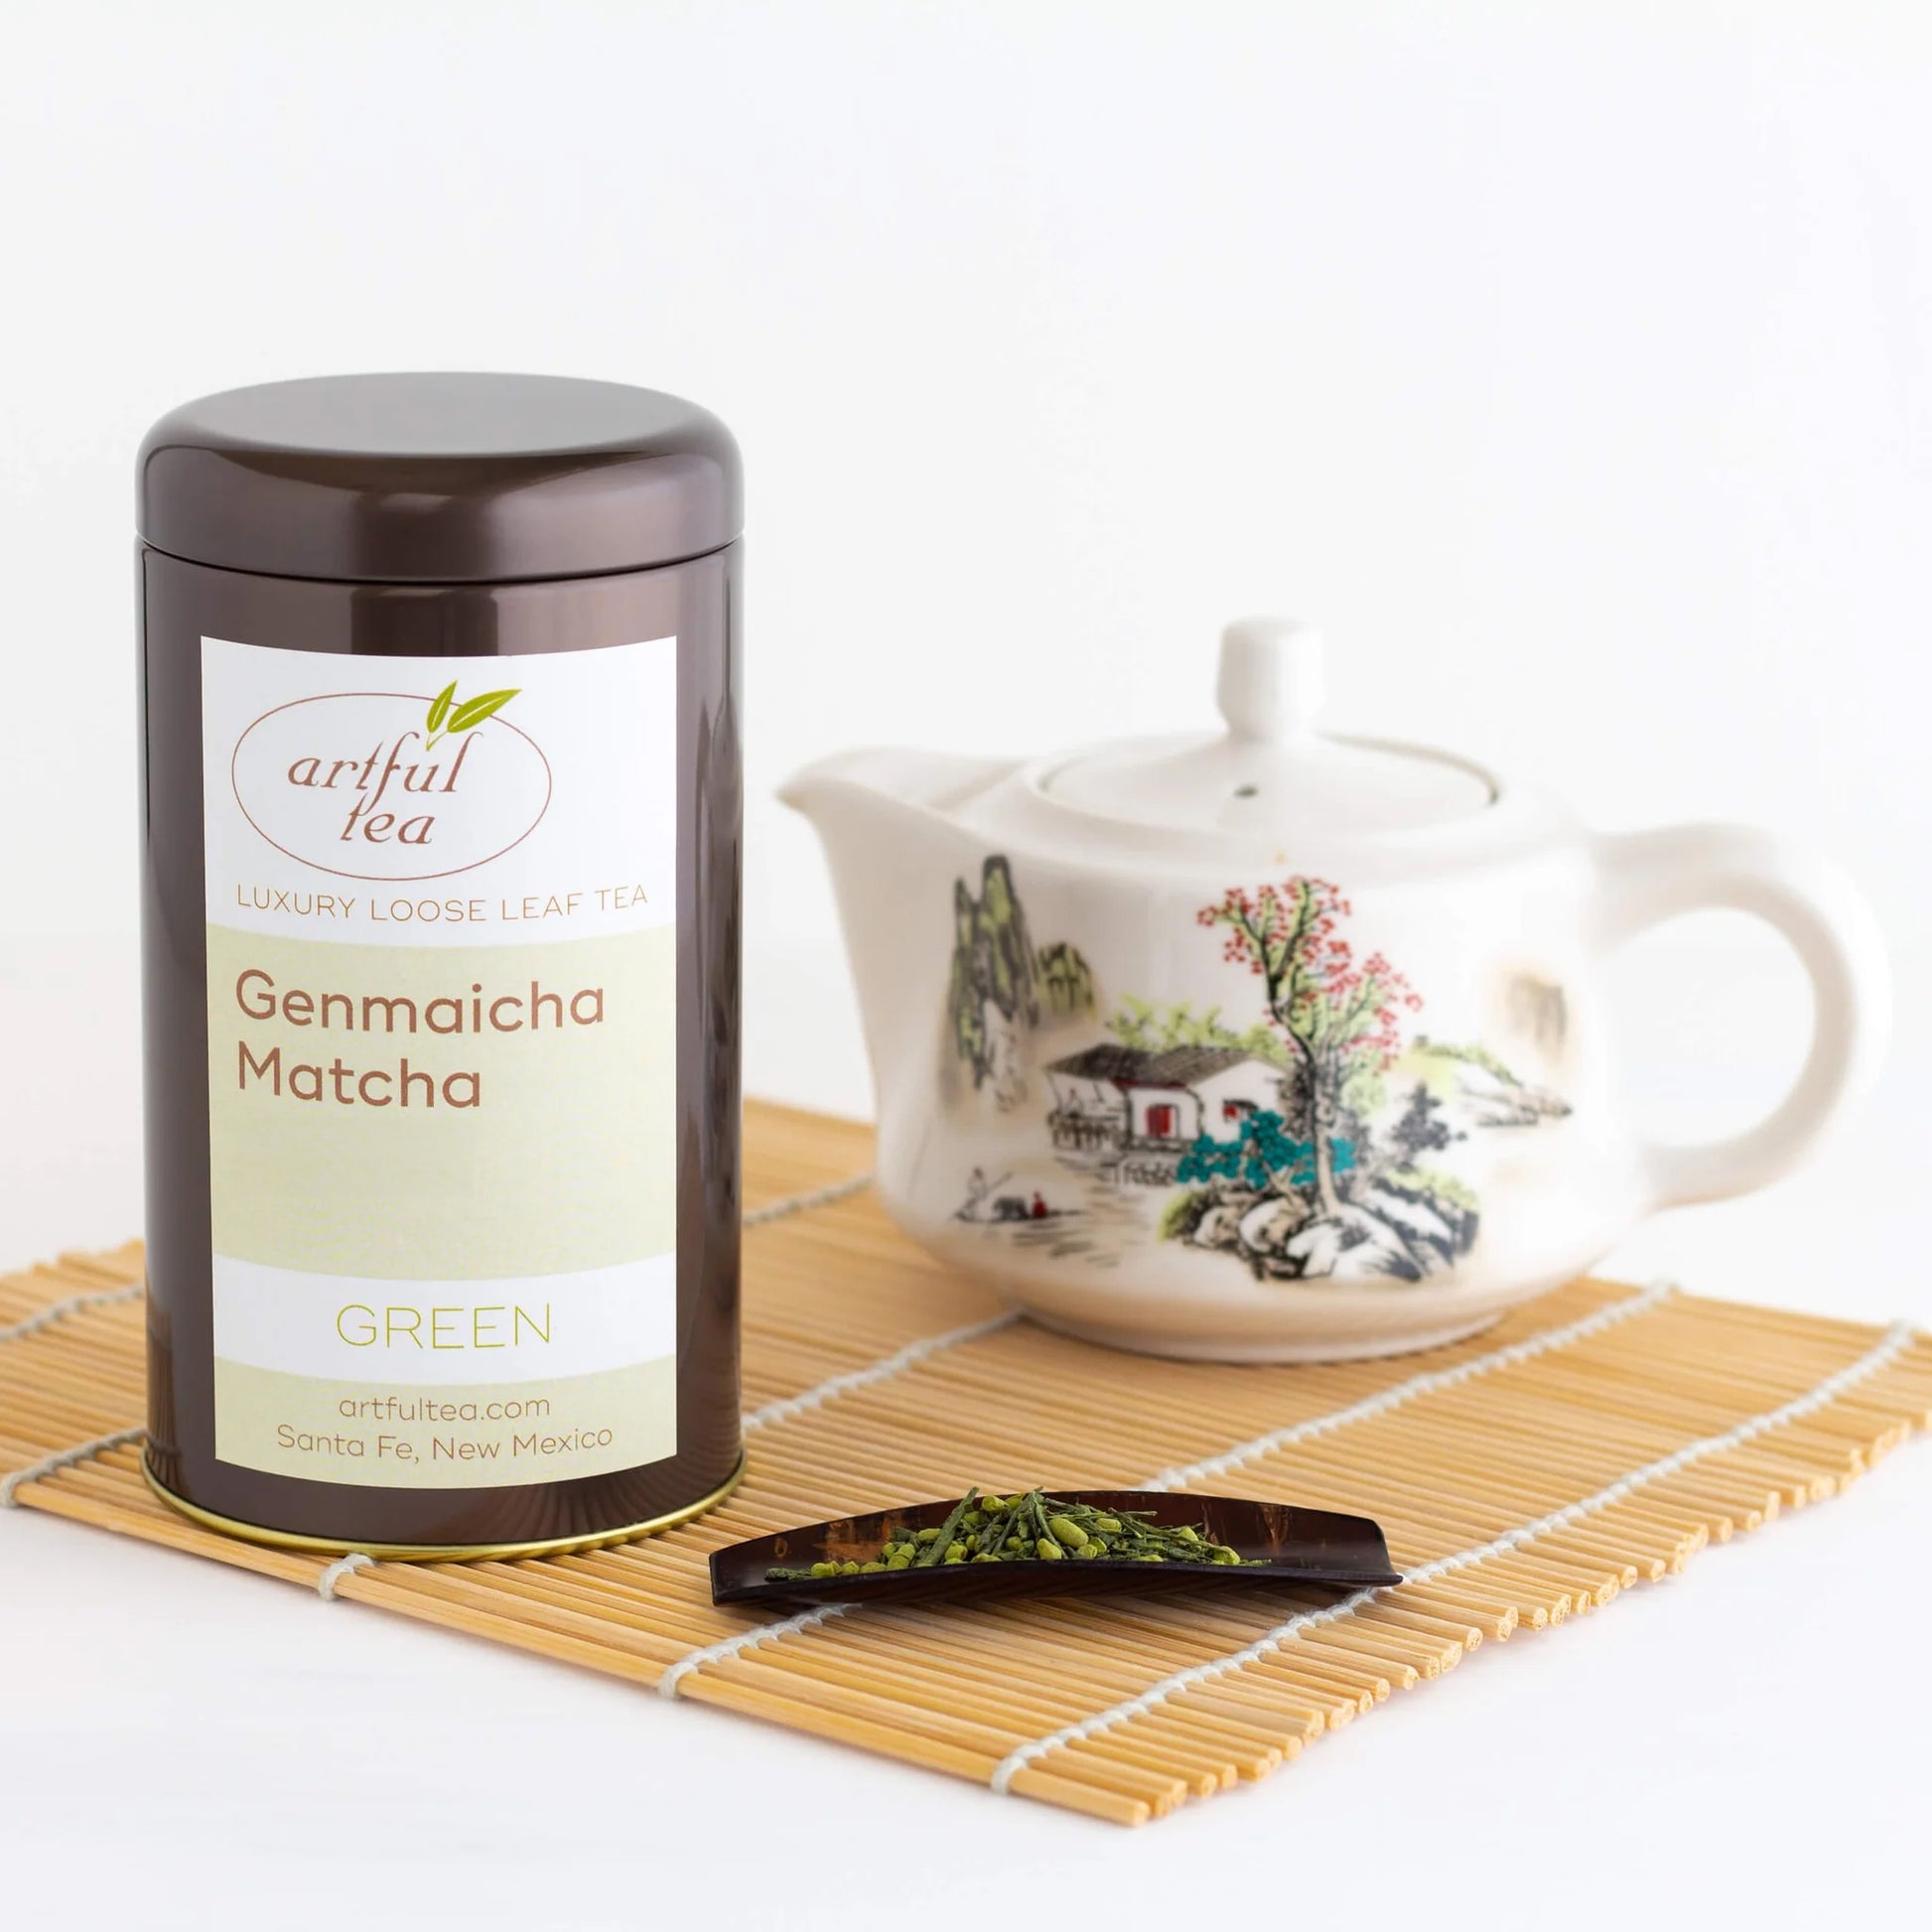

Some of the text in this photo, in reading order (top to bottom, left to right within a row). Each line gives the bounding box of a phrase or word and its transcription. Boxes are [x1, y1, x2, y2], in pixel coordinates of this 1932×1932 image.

[288, 731, 483, 815] artful
[340, 793, 436, 845] tea
[236, 884, 648, 922] LUXURY LOOSE LEAF TEA
[235, 968, 605, 1035] Genmaicha
[237, 1039, 482, 1108] Matcha
[336, 1302, 551, 1350] GREEN
[339, 1396, 551, 1423] artfultea.com
[277, 1424, 613, 1464] Santa Fe, New Mexico
